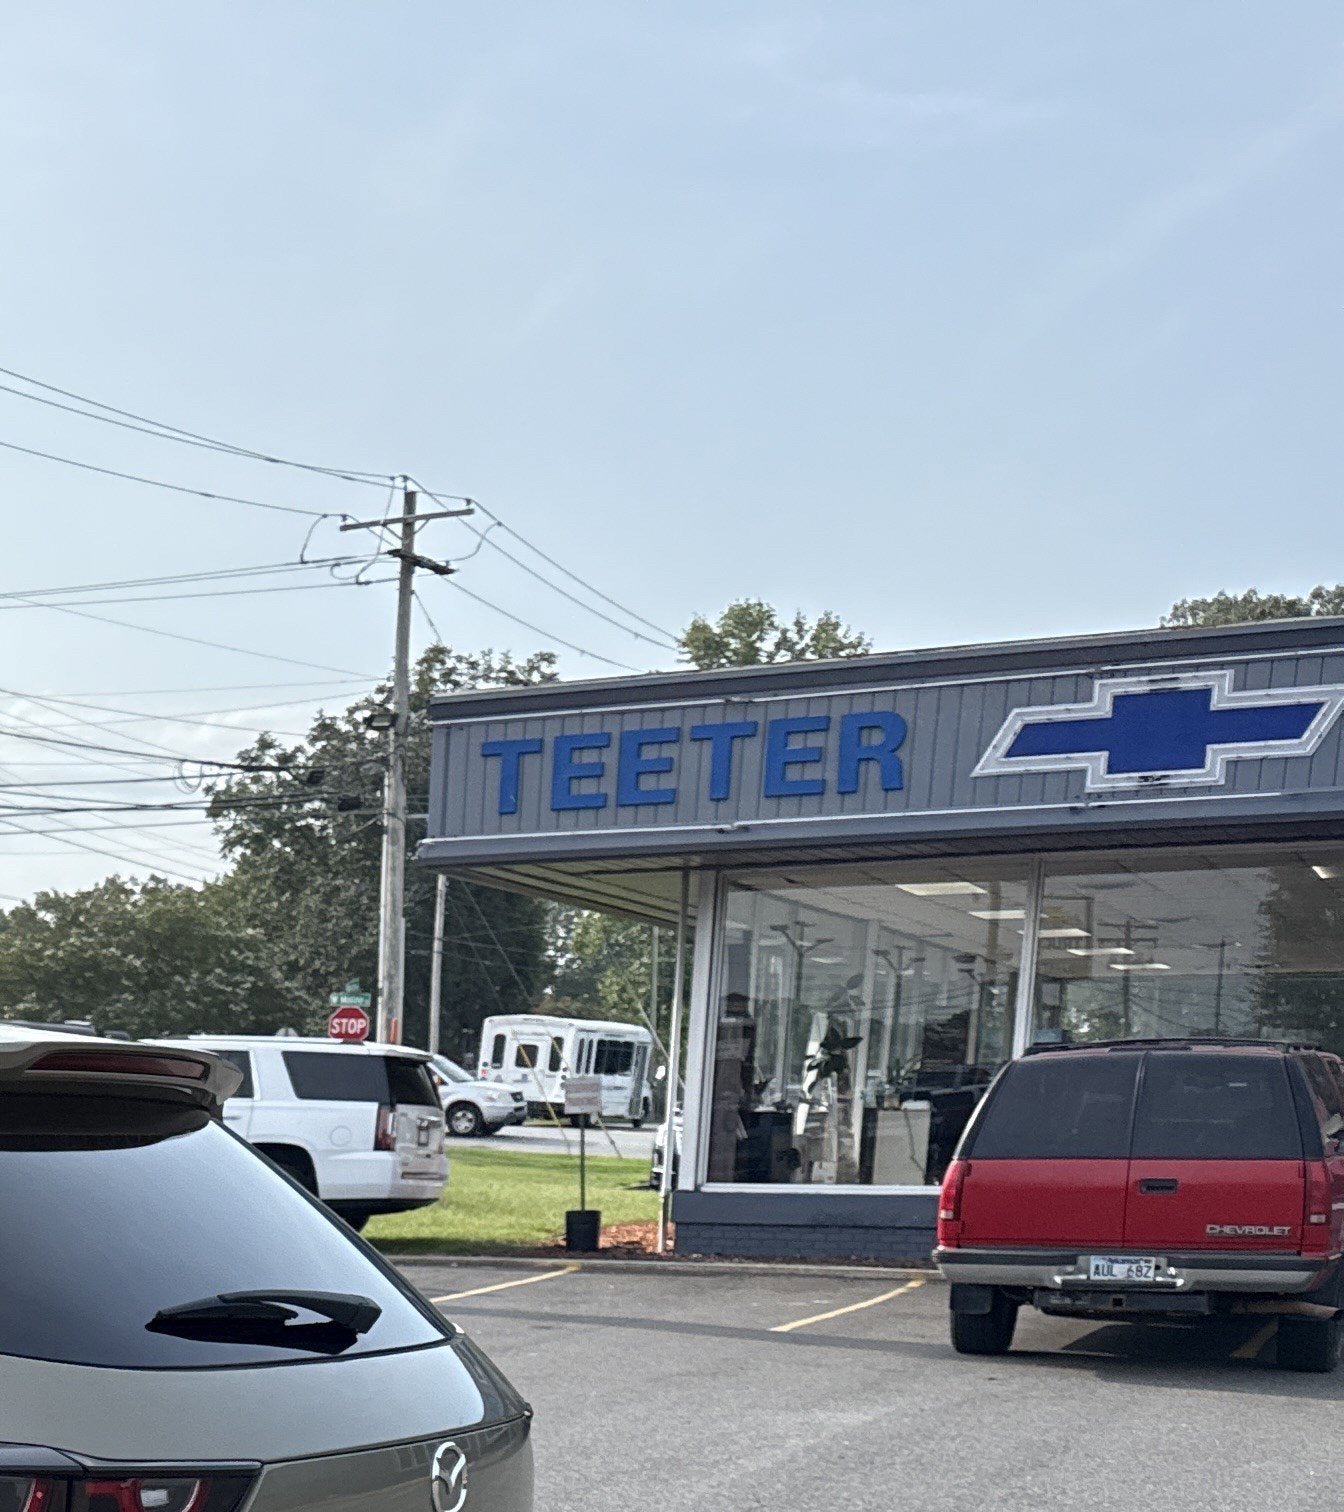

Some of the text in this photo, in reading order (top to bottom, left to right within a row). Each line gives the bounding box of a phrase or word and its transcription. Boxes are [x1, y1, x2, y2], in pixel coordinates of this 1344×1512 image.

[481, 711, 908, 815] TEETER
[331, 1017, 367, 1035] STOP
[1206, 1224, 1291, 1236] CHEVROLET
